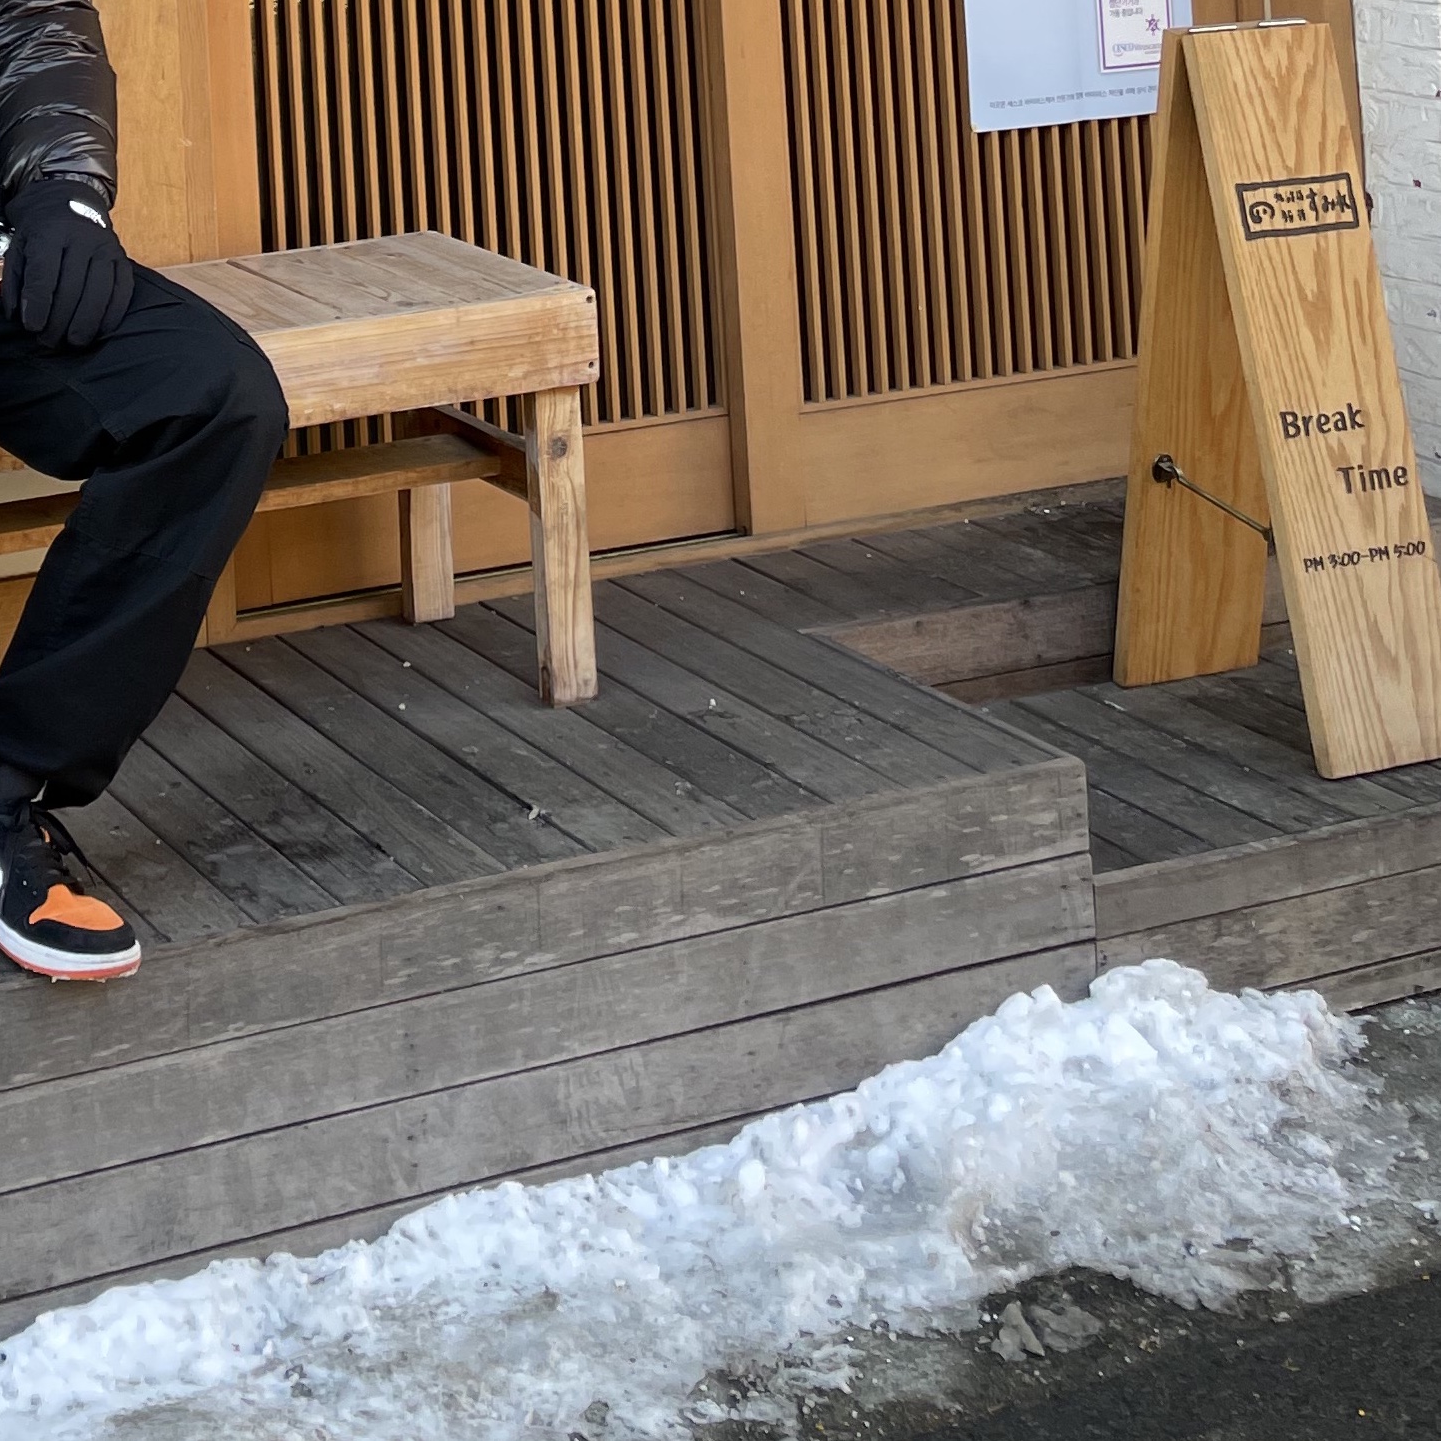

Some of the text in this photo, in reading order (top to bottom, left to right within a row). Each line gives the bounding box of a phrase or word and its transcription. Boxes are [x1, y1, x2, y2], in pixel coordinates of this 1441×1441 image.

[1279, 402, 1365, 440] Break
[1336, 464, 1409, 494] Time
[1303, 556, 1324, 573] PM
[1393, 540, 1426, 558] 5:00
